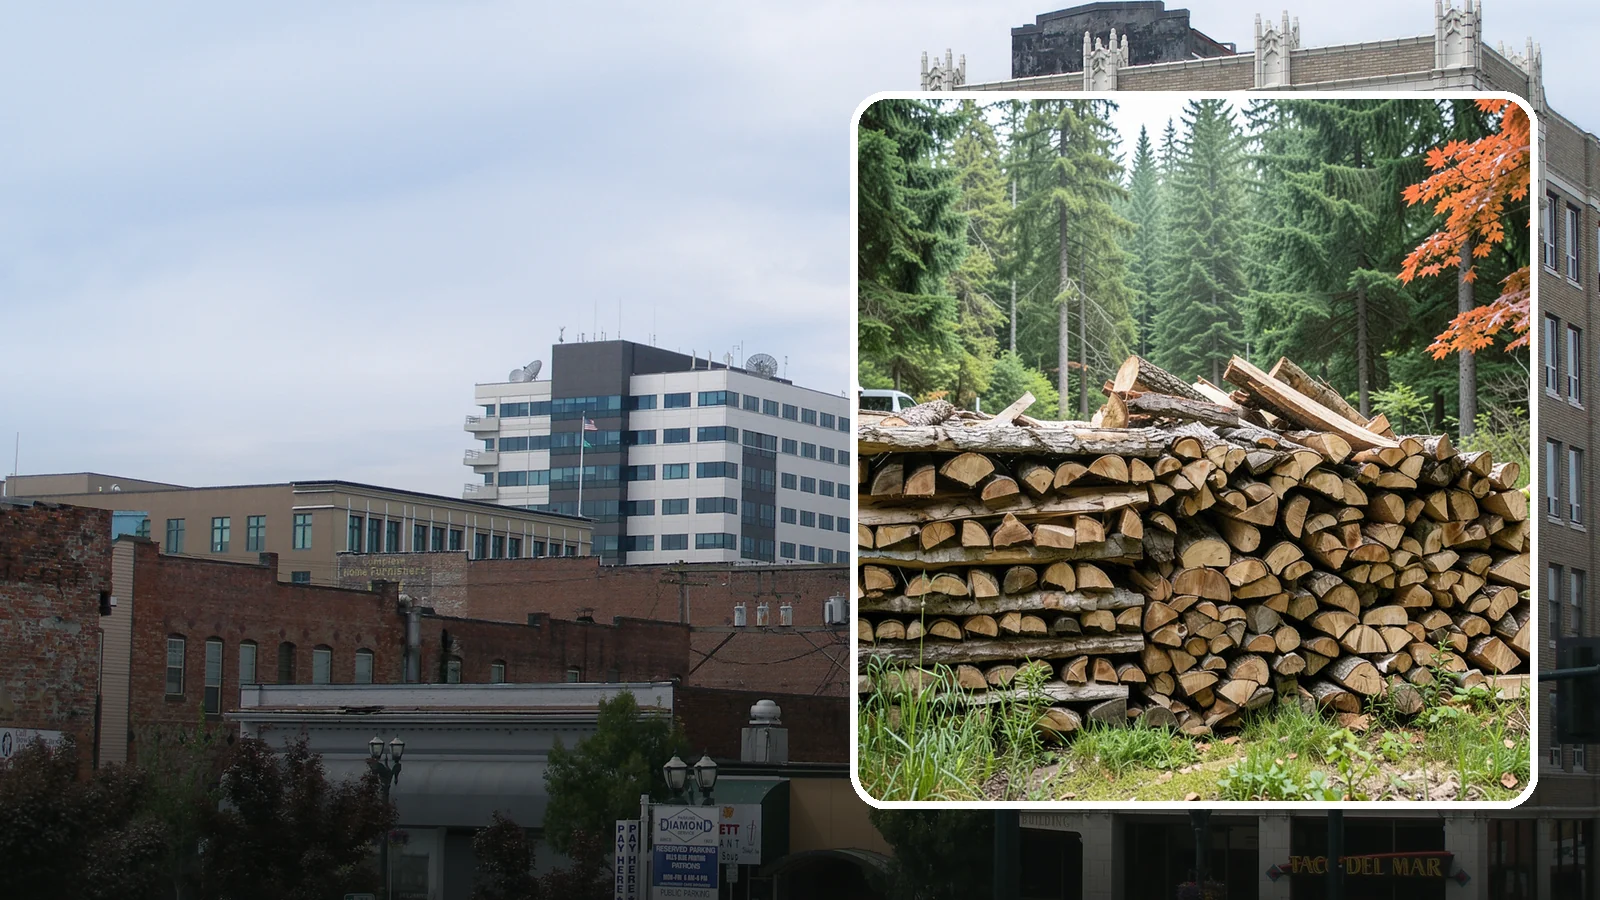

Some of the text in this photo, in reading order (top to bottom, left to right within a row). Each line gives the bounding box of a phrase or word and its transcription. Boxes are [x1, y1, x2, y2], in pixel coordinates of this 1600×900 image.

[343, 568, 368, 577] Home
[660, 818, 713, 833] DIAMOND
[1022, 814, 1070, 828] BUILDING
[656, 845, 688, 853] RESERVED
[616, 824, 626, 894] PAY HERE
[627, 824, 637, 894] PAY HERE
[721, 852, 739, 863] Soup
[671, 862, 701, 870] PATRONS
[1346, 856, 1385, 876] DEL
[1392, 857, 1442, 877] MAR
[660, 888, 710, 899] PUBLIC PARKING
